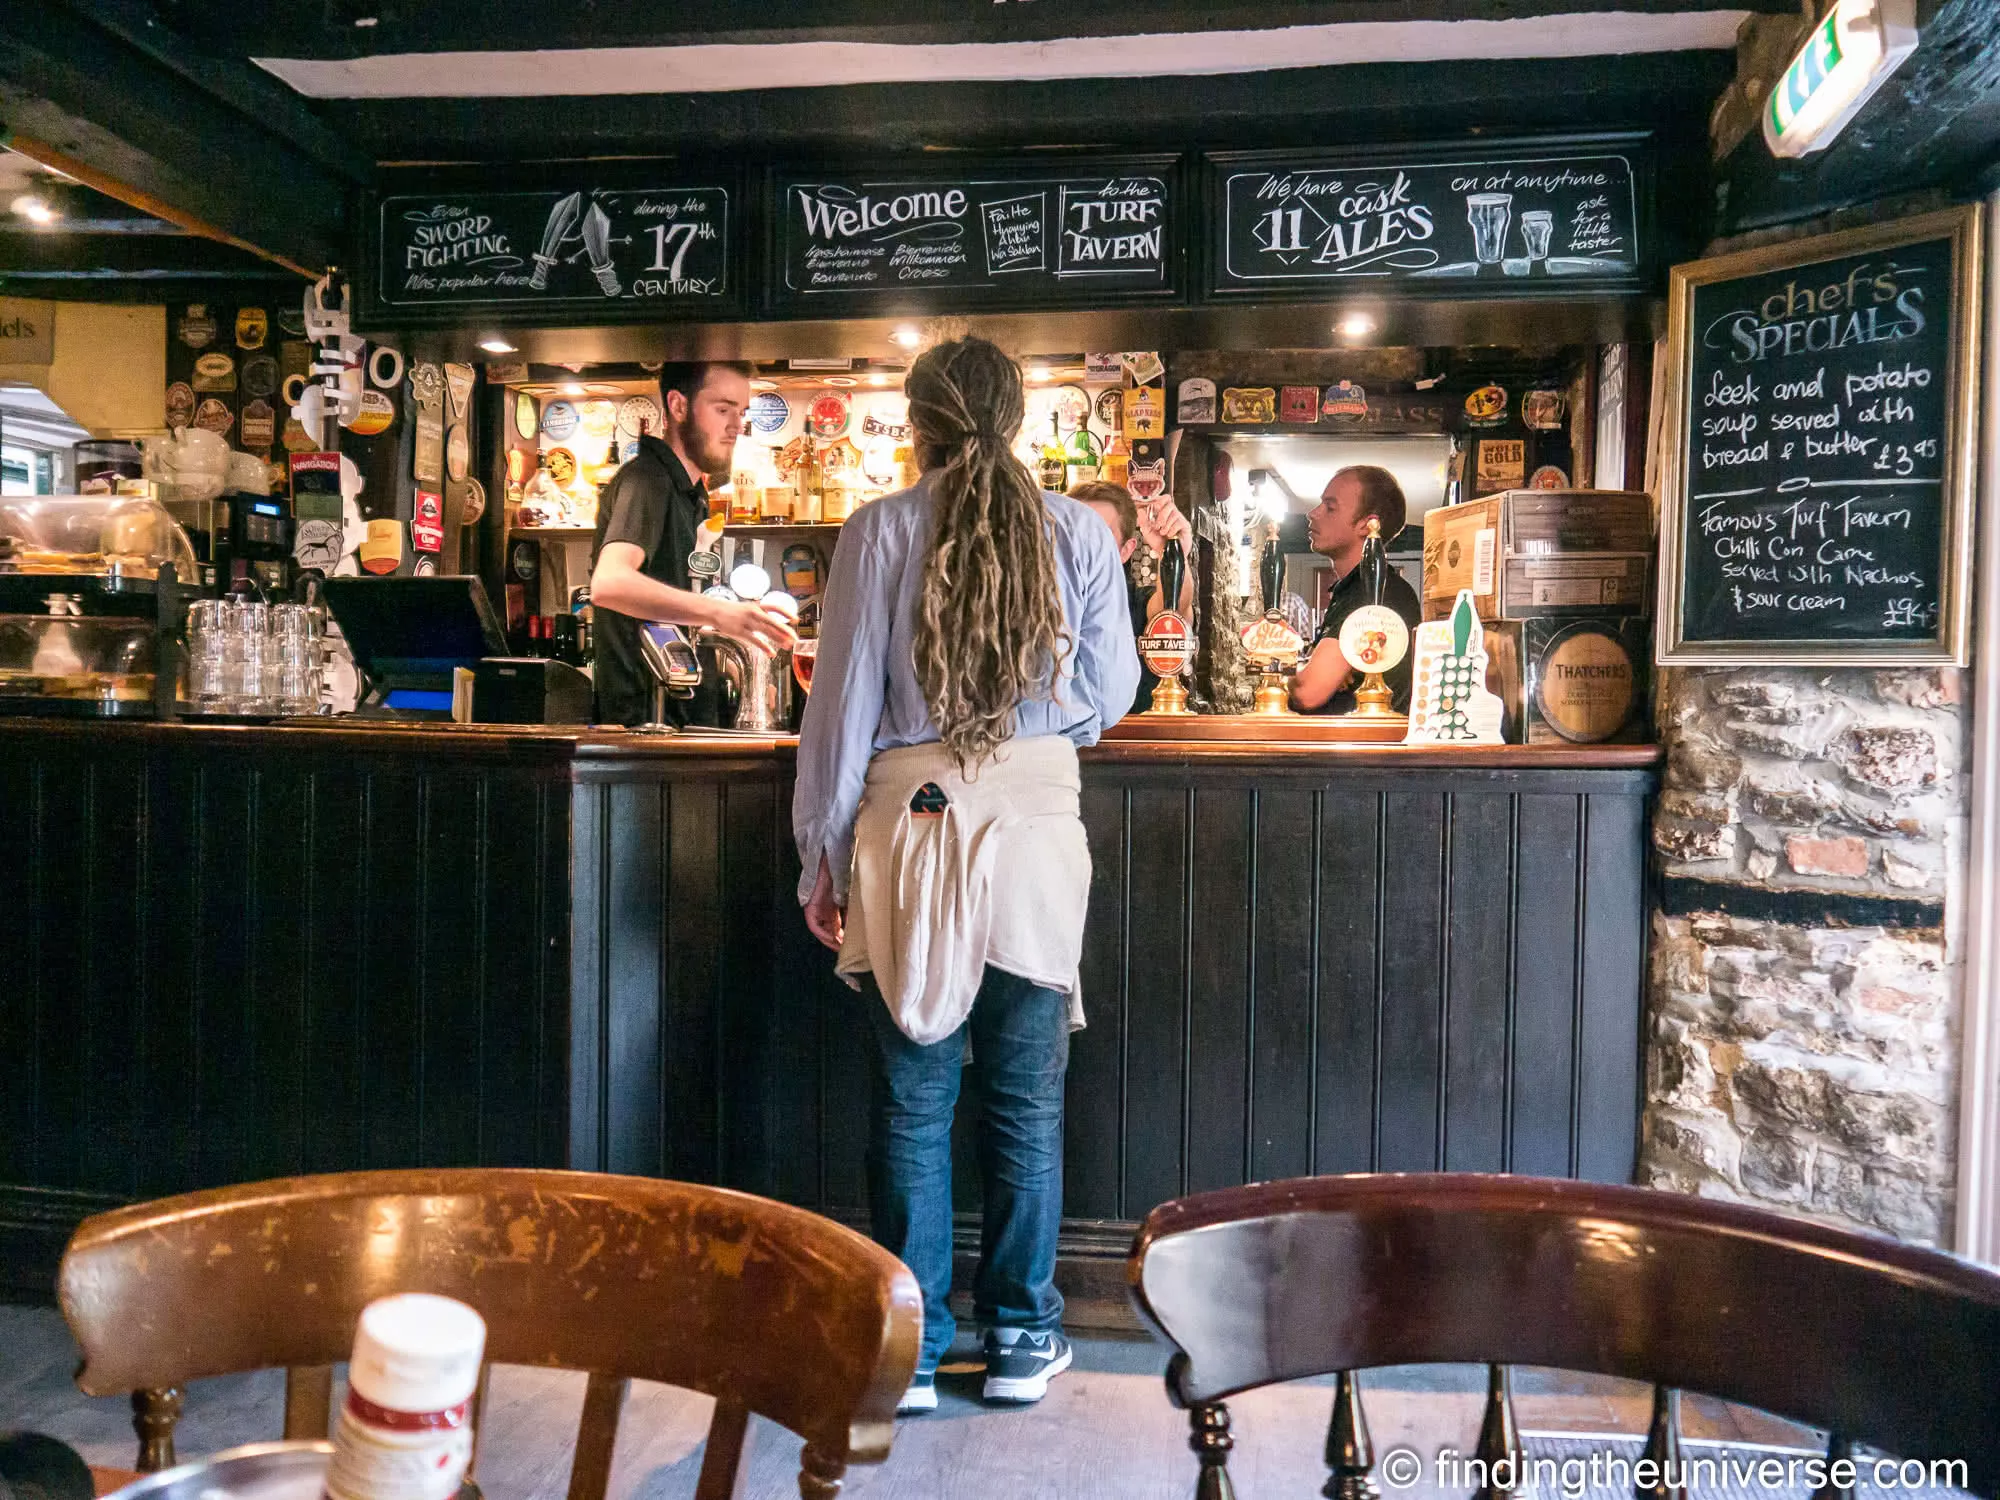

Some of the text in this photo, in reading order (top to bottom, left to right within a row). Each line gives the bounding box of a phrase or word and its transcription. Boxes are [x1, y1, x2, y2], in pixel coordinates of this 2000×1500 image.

[1100, 179, 1150, 197] to the
[1256, 174, 1344, 199] We have
[1451, 177, 1477, 192] on
[1484, 169, 1512, 190] at
[1339, 171, 1411, 217] cask
[1576, 195, 1608, 210] ask
[633, 198, 706, 219] during the
[797, 189, 968, 240] Welcome
[1069, 199, 1163, 233] TURF
[1570, 213, 1611, 226] for a
[414, 215, 492, 246] SWORD
[1259, 208, 1310, 252] 11
[1311, 205, 1434, 264] ALES
[1573, 221, 1610, 237] little
[406, 234, 511, 269] FIGHTING
[1064, 225, 1162, 261] TAVERN
[1568, 237, 1623, 251] taster
[437, 273, 492, 292] popular
[633, 278, 716, 297] CENTURY
[1731, 287, 1927, 364] SPECIALS
[1704, 361, 1931, 408] Leek and potato
[873, 422, 901, 437] TSB
[1702, 398, 1914, 444] soup served with
[1484, 451, 1522, 465] GOLD
[1702, 440, 1768, 470] bread
[1780, 441, 1795, 460] &
[1806, 430, 1878, 457] butter
[292, 460, 339, 472] NAVIGATION
[1698, 495, 1911, 540] Famous Turf Tavern
[1715, 536, 1876, 565] Chilli Con Carne
[1846, 564, 1925, 589] Nachos
[1140, 639, 1196, 650] TURF TAVERN
[1555, 663, 1627, 680] THATCHERS
